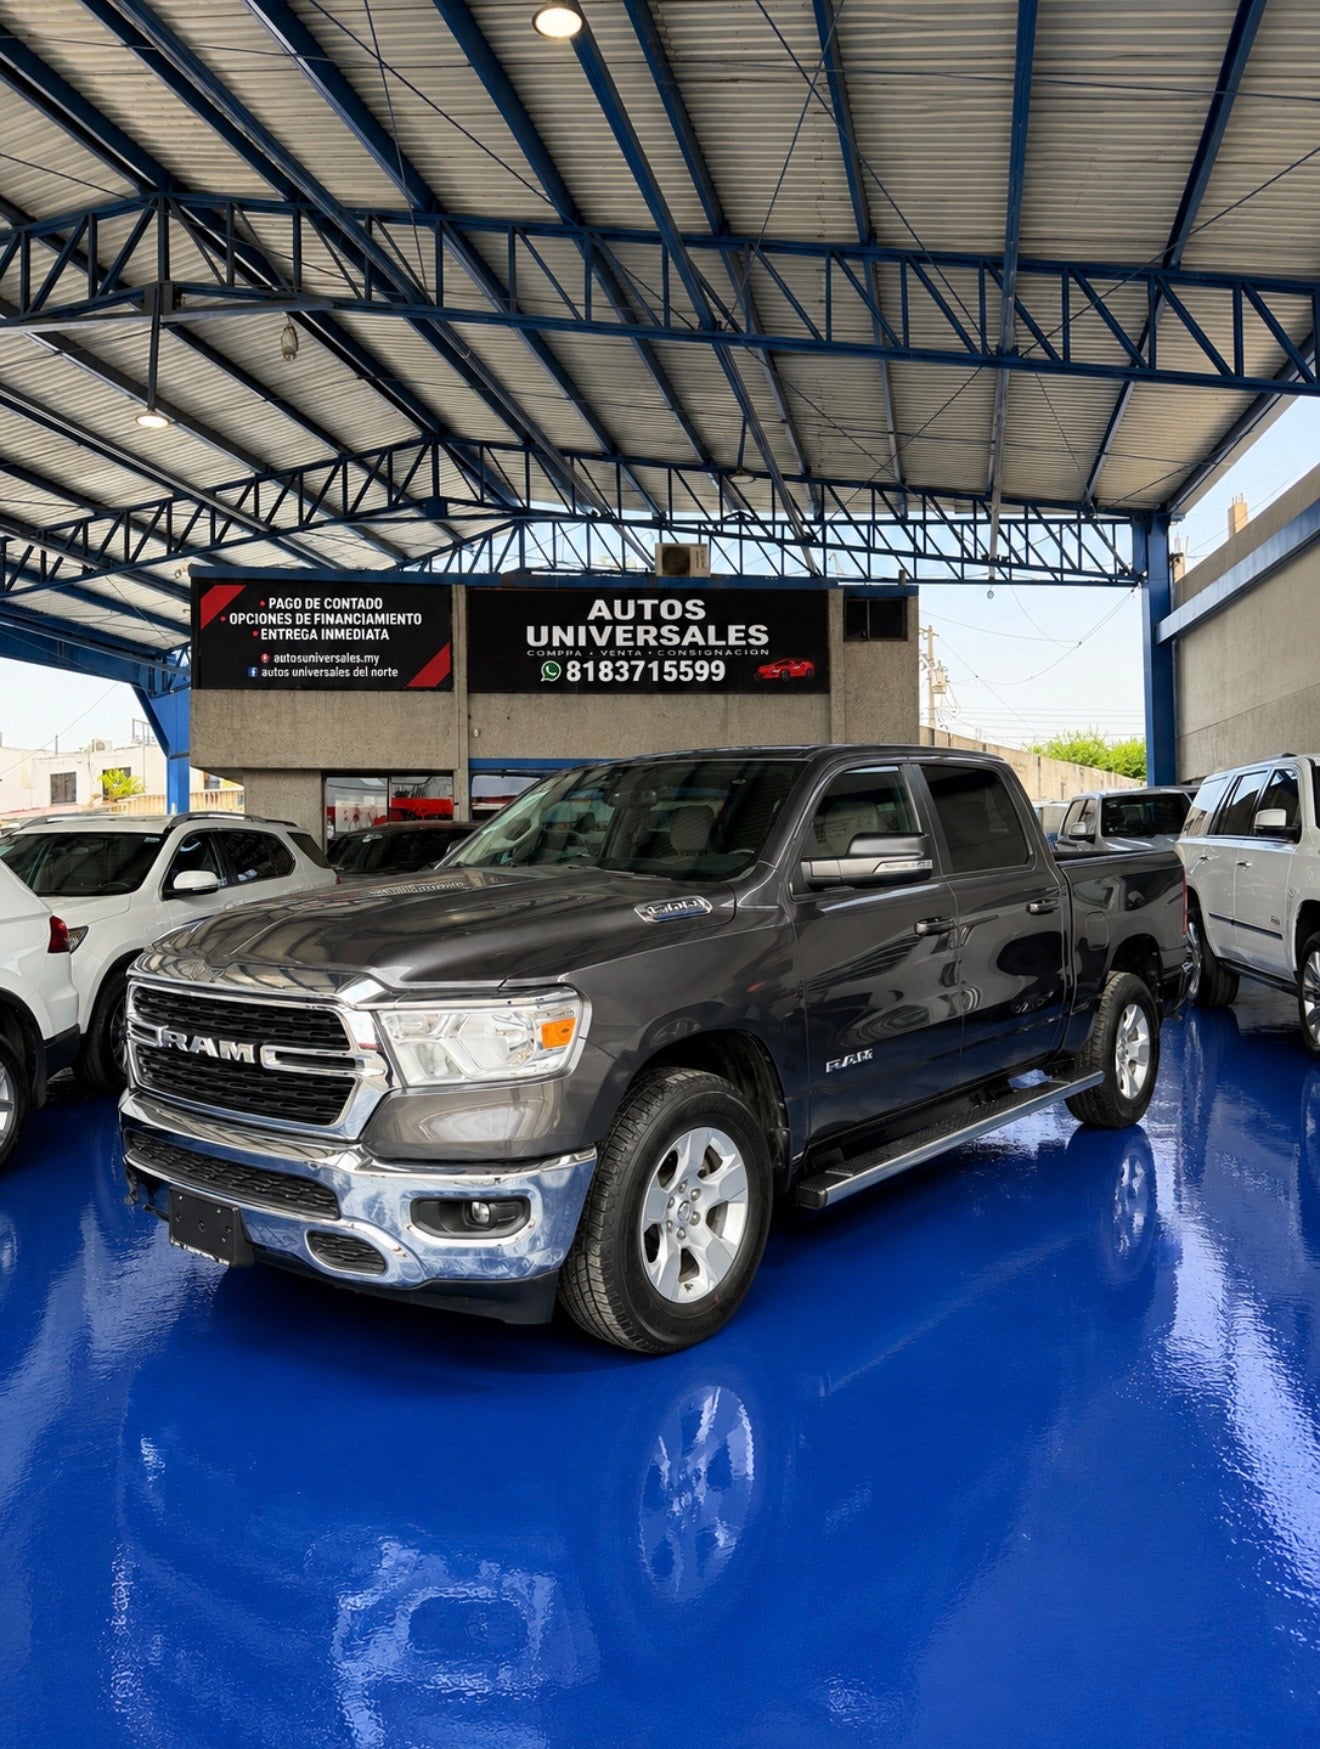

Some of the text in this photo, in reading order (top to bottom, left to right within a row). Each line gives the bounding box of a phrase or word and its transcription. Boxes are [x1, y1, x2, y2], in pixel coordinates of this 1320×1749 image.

[268, 597, 384, 611] PAGO DE CONTADO
[586, 598, 707, 621] AUTOS
[229, 612, 423, 626] OPCIONES DE FINANCIAMIENTO
[260, 628, 390, 641] ENTREGA INMEDIATA
[526, 624, 770, 648] UNIVERSALES
[273, 652, 380, 666] autosuniversales.my
[657, 648, 770, 657] CONSIGNACION
[261, 666, 399, 677] autos universales del norte
[566, 660, 726, 683] 8183715599
[162, 1029, 255, 1063] RAM
